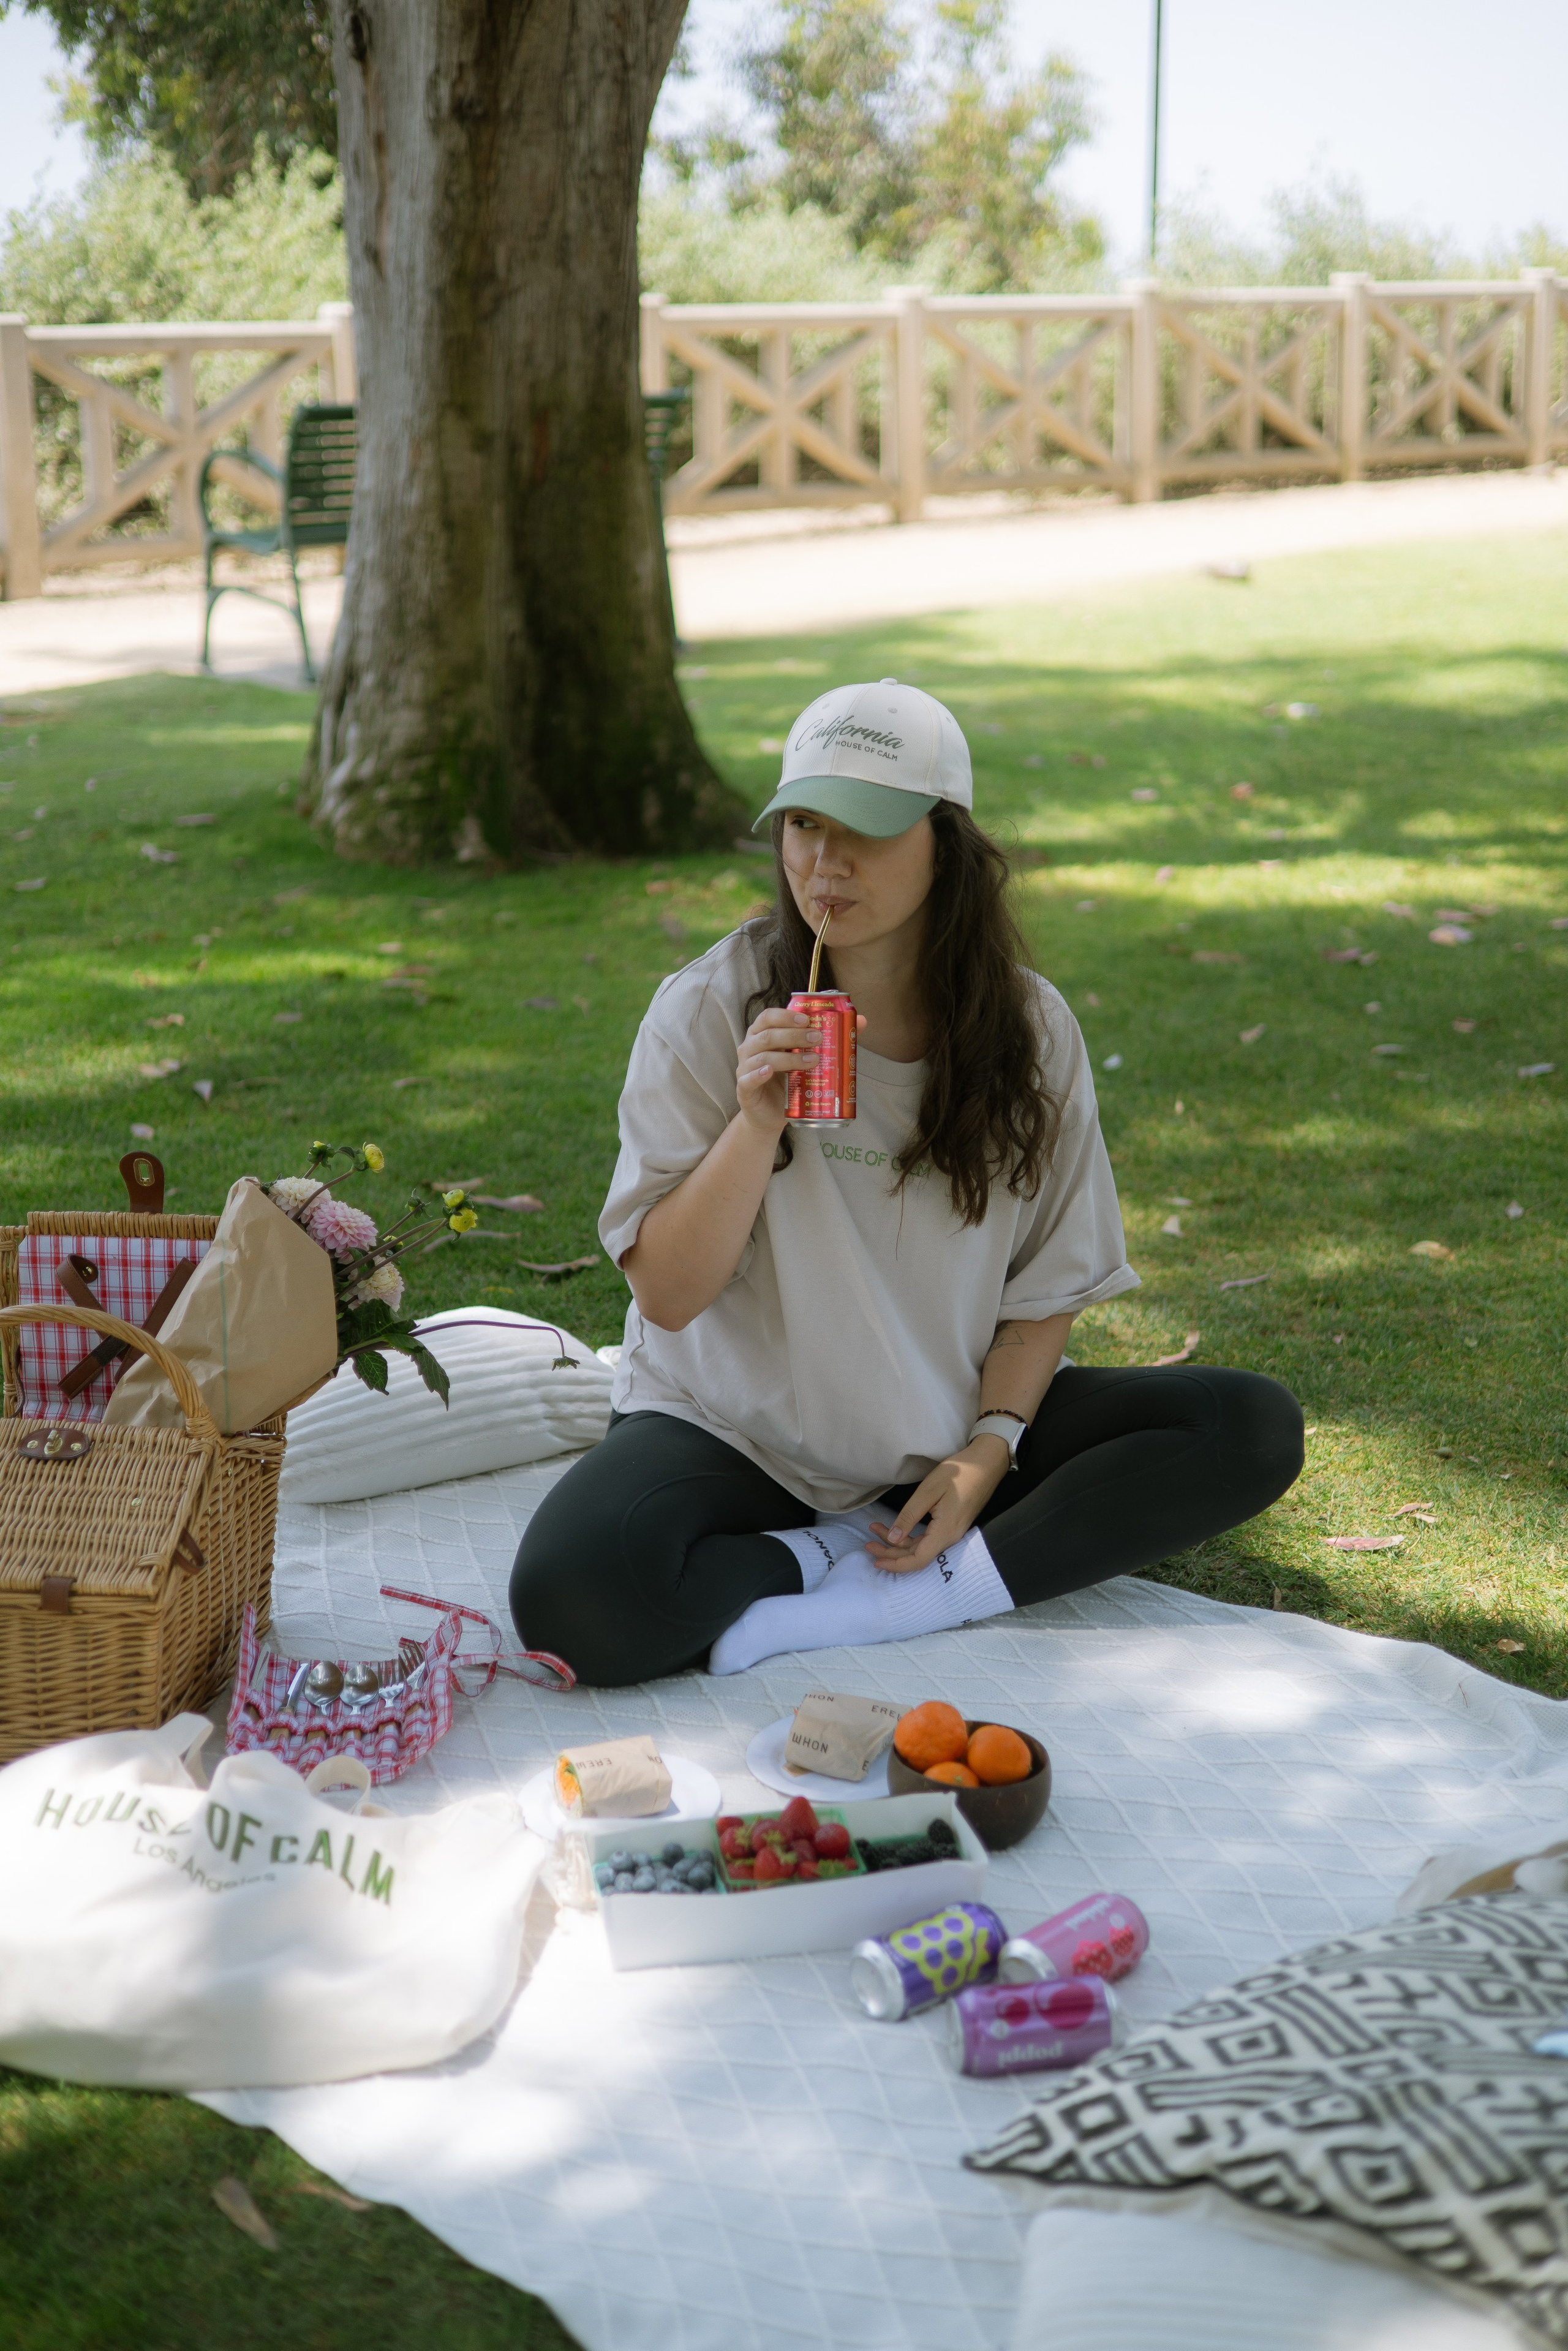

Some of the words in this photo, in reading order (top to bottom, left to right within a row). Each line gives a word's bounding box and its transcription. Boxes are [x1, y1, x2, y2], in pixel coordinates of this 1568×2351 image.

[795, 715, 905, 752] California
[835, 740, 862, 750] HOUSE
[877, 750, 898, 761] CALM
[821, 1141, 862, 1163] OUSE
[864, 1150, 888, 1166] OF
[892, 1156, 930, 1179] CM
[937, 1552, 953, 1584] OLA
[805, 1694, 834, 1702] HON
[134, 1837, 178, 1864] Los
[206, 1801, 262, 1863] OF
[270, 1828, 394, 1906] CALM
